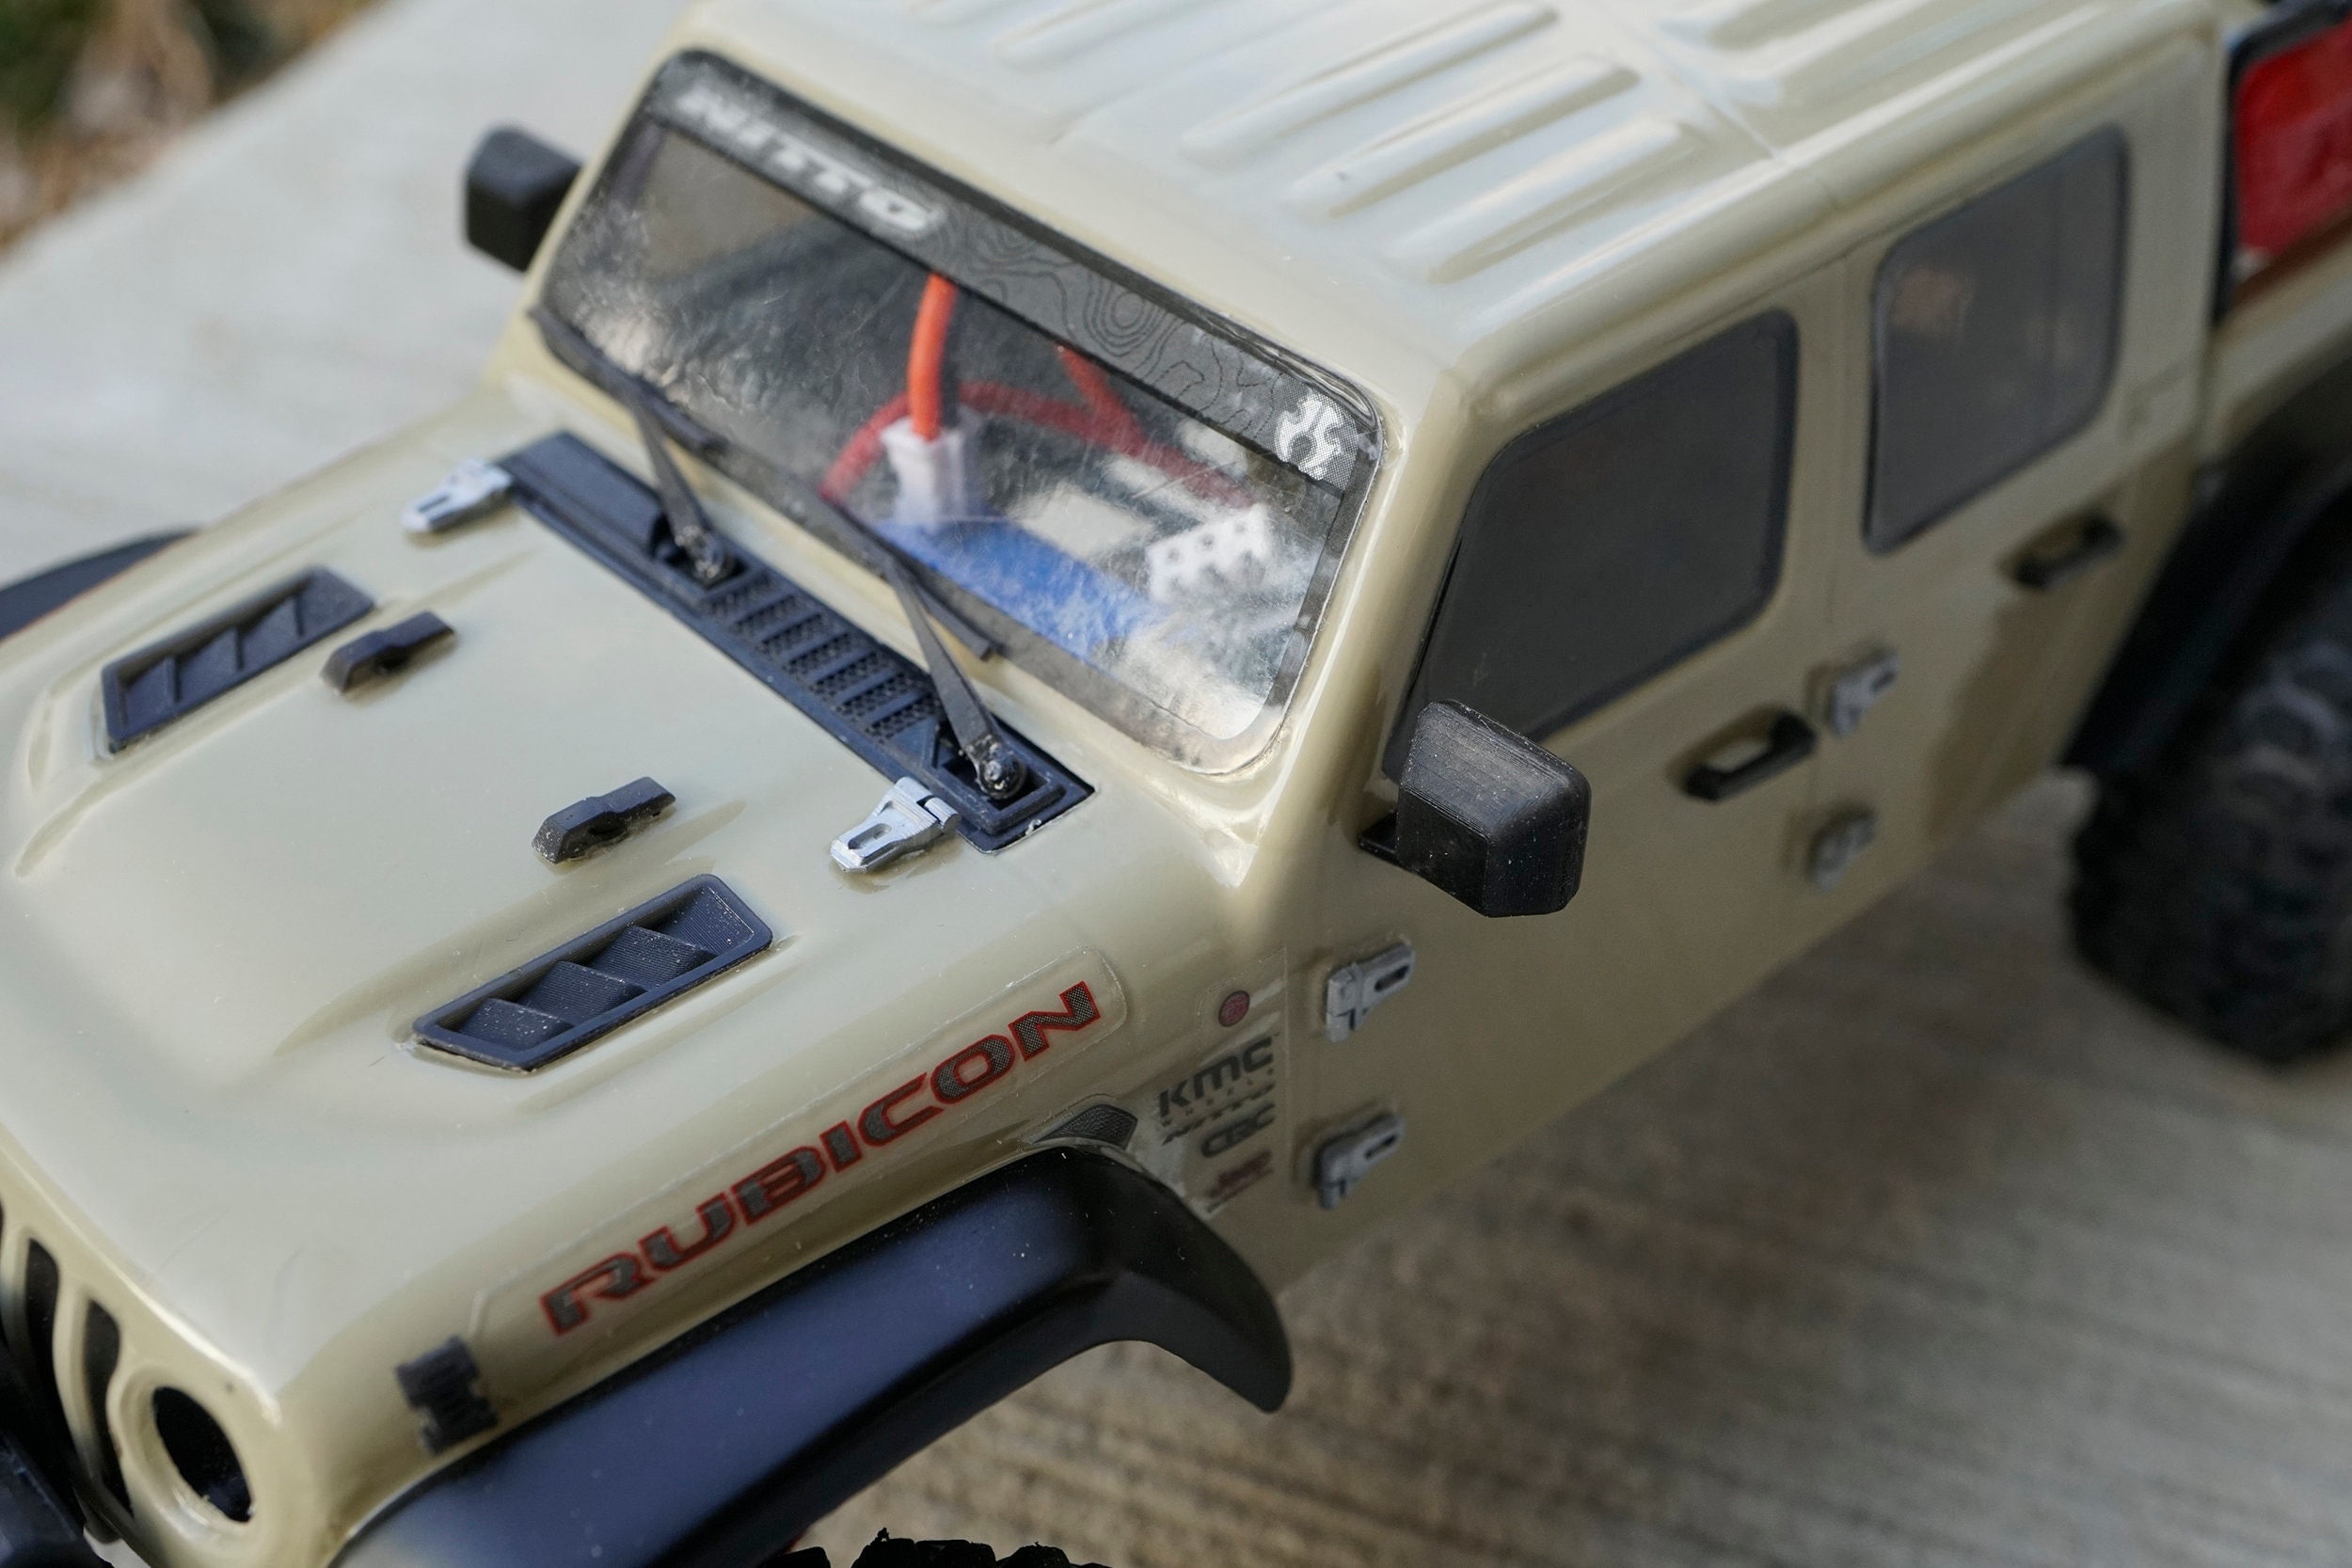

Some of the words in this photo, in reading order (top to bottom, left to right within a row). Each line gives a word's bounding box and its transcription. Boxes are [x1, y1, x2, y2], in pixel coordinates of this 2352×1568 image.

[675, 88, 935, 233] NITTO
[1158, 1036, 1274, 1117] KMC
[539, 980, 1101, 1337] RUBICON
